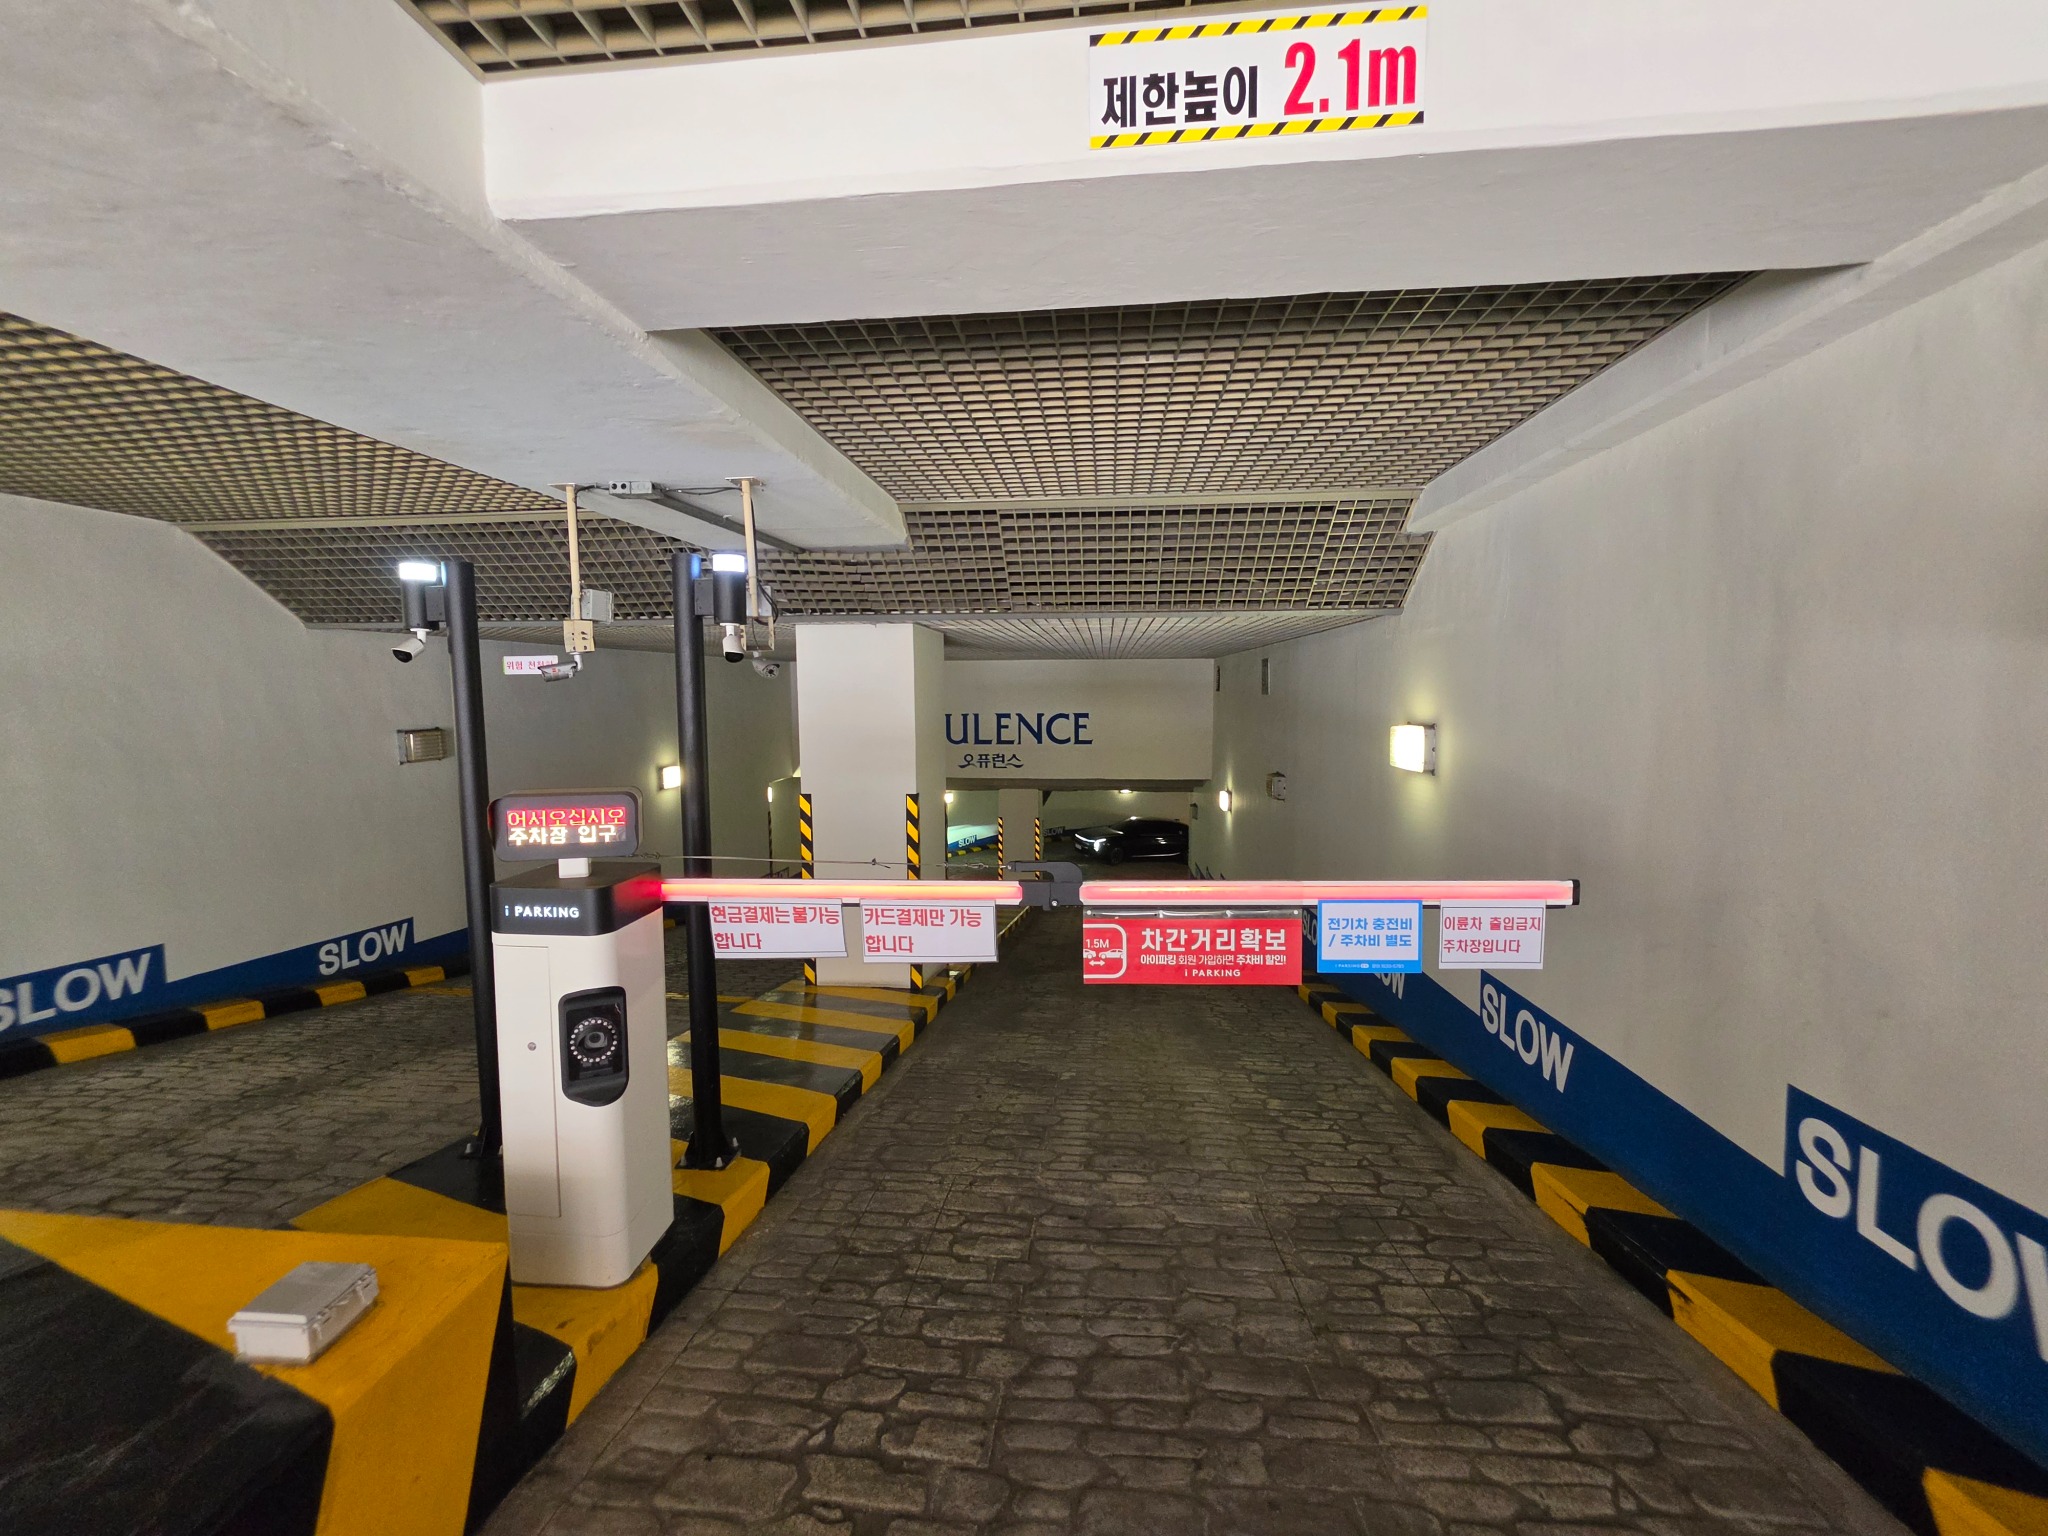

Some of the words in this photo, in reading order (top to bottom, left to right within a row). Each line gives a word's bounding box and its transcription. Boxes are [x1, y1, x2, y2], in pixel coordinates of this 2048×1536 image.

[1101, 65, 1258, 128] 제한높이
[1283, 38, 1416, 116] 2.1m
[506, 661, 523, 671] 위험
[945, 712, 1093, 745] ULENCE
[958, 753, 1024, 769] 오퓨런스
[507, 808, 625, 827] 어서오십시오
[508, 826, 568, 846] 주차장
[577, 825, 617, 843] 입구
[958, 834, 978, 848] SLOW
[514, 905, 580, 919] PARKING
[864, 908, 945, 928] 카드결제만
[949, 908, 982, 928] 가능
[1302, 909, 1317, 946] SLO
[1327, 917, 1368, 931] 전기차
[1372, 917, 1413, 931] 충전비
[1443, 916, 1483, 931] 이륜차
[1489, 917, 1541, 932] 출입금지
[714, 932, 762, 950] 합니다
[865, 935, 914, 954] 합니다
[1085, 938, 1110, 949] 1.5M
[1141, 928, 1286, 952] 차간거리확보
[1340, 934, 1380, 947] 주차비
[1385, 934, 1412, 947] 별도
[1443, 938, 1521, 954] 주차장입니다
[318, 923, 409, 976] SLOW
[1140, 954, 1177, 966] 아이파킹
[1178, 954, 1197, 965] 회원
[1198, 954, 1235, 966] 가입하면
[1236, 954, 1264, 966] 주차비
[1265, 954, 1287, 966] 할인!
[1192, 968, 1241, 977] PARKING
[1482, 983, 1574, 1094] SLOW
